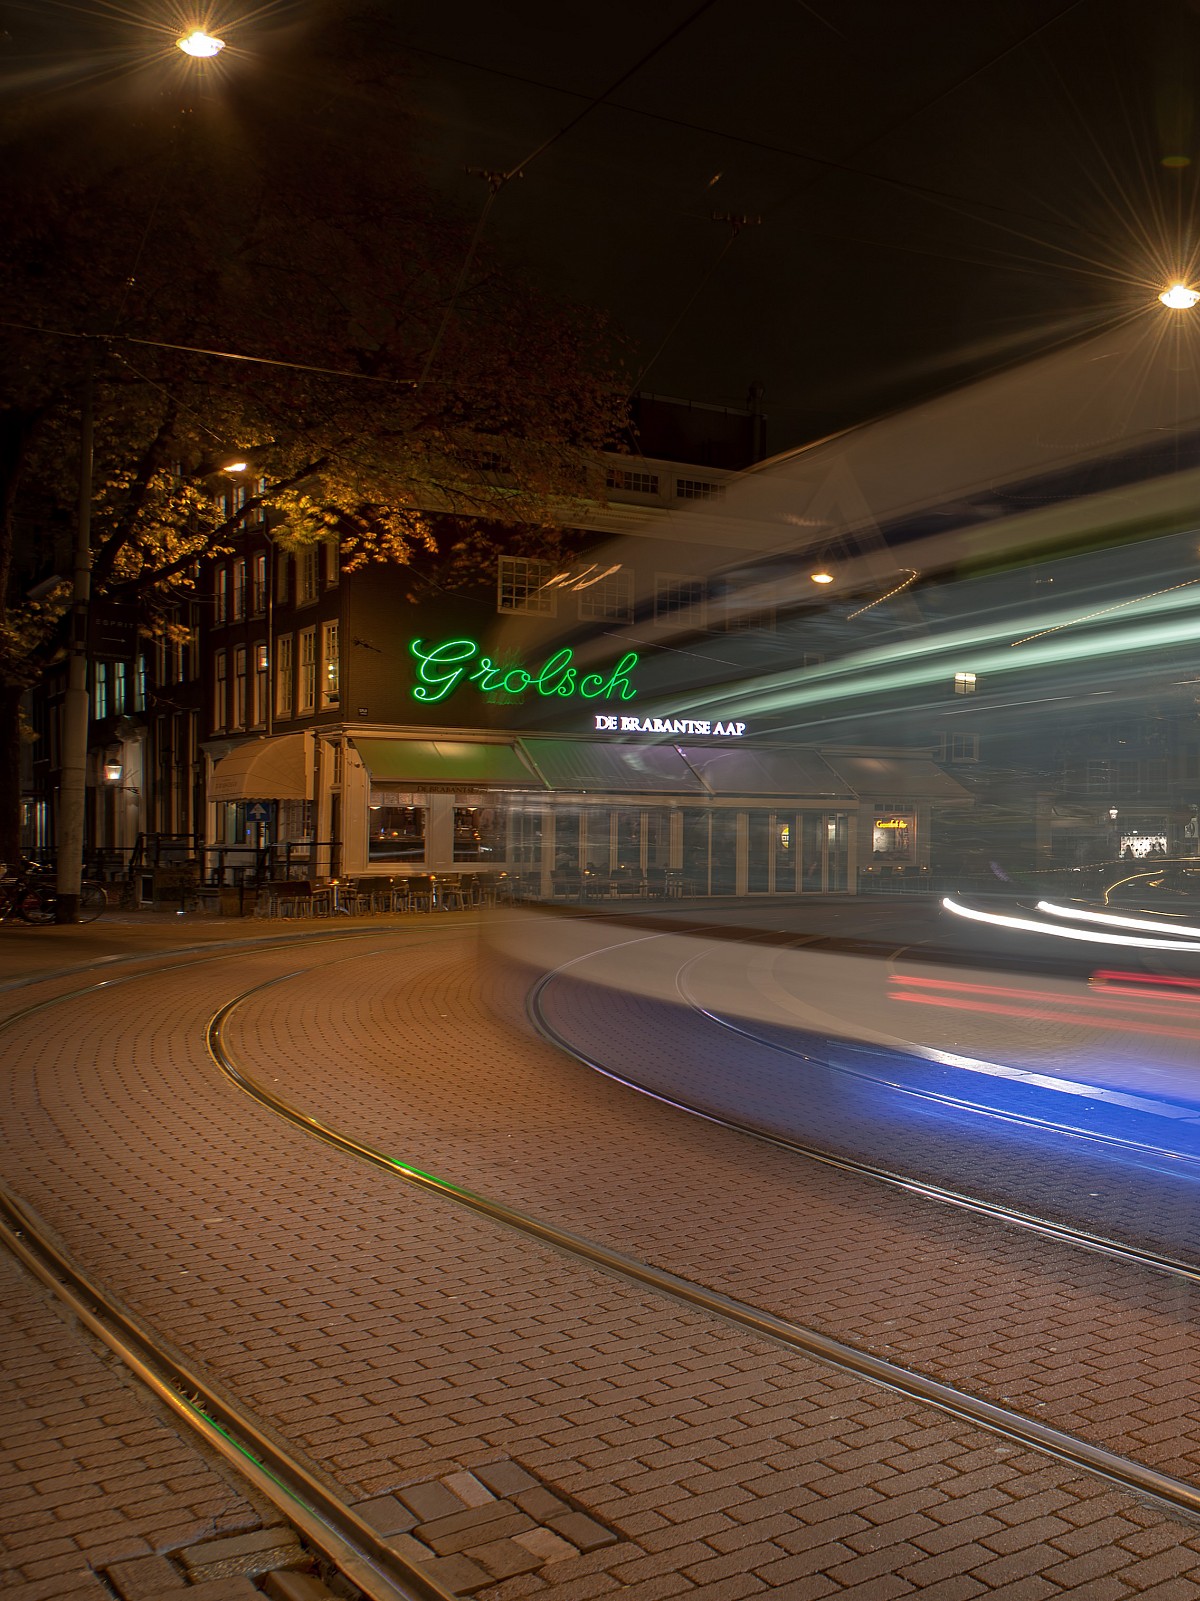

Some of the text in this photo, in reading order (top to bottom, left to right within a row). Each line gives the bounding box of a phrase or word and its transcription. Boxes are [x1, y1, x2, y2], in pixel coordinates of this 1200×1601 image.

[95, 618, 134, 629] ESPRIT
[411, 639, 639, 701] Grolsch
[595, 715, 746, 736] DE BRABANTSE AAP
